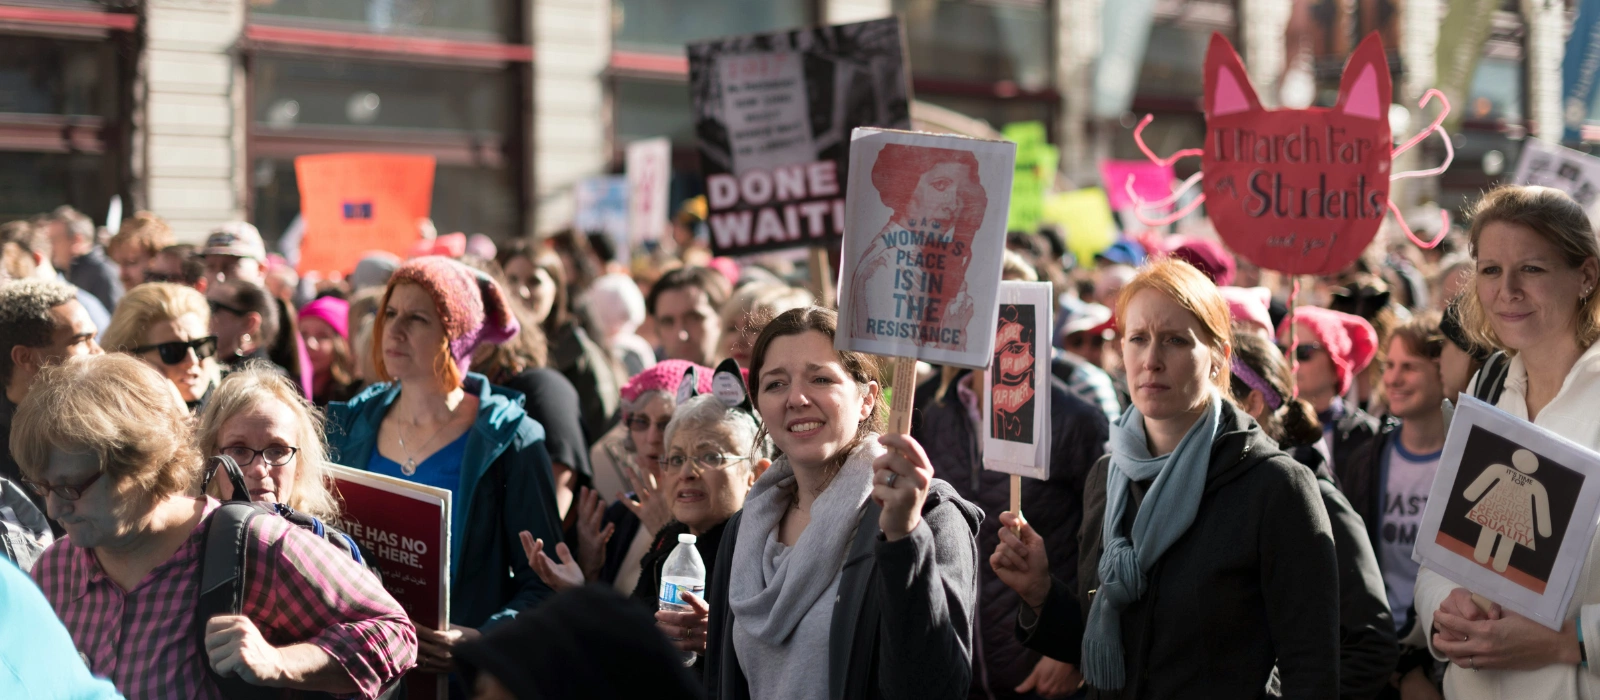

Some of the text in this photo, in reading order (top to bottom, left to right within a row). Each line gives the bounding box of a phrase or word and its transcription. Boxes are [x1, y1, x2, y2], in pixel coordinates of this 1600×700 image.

[1214, 128, 1229, 161] I
[707, 159, 839, 209] DONE
[1242, 168, 1385, 220] Students
[920, 217, 927, 227] A
[881, 230, 965, 256] WOMAN'S
[896, 249, 945, 270] PLACE
[894, 268, 943, 294] IS IN
[893, 293, 942, 323] THE
[866, 318, 961, 345] RESISTANCE
[994, 382, 1029, 408] OUR POWER
[1506, 468, 1533, 485] IT'S TIME
[1511, 477, 1525, 487] FOR
[1490, 493, 1529, 515] JUSTICE
[1496, 486, 1529, 506] PEACE
[1478, 504, 1531, 535] RESPECT
[1484, 498, 1530, 525] DIGNITY
[327, 519, 428, 555] ATE HAS NO
[1469, 509, 1533, 546] EQUALITY
[378, 544, 423, 569] HERE.
